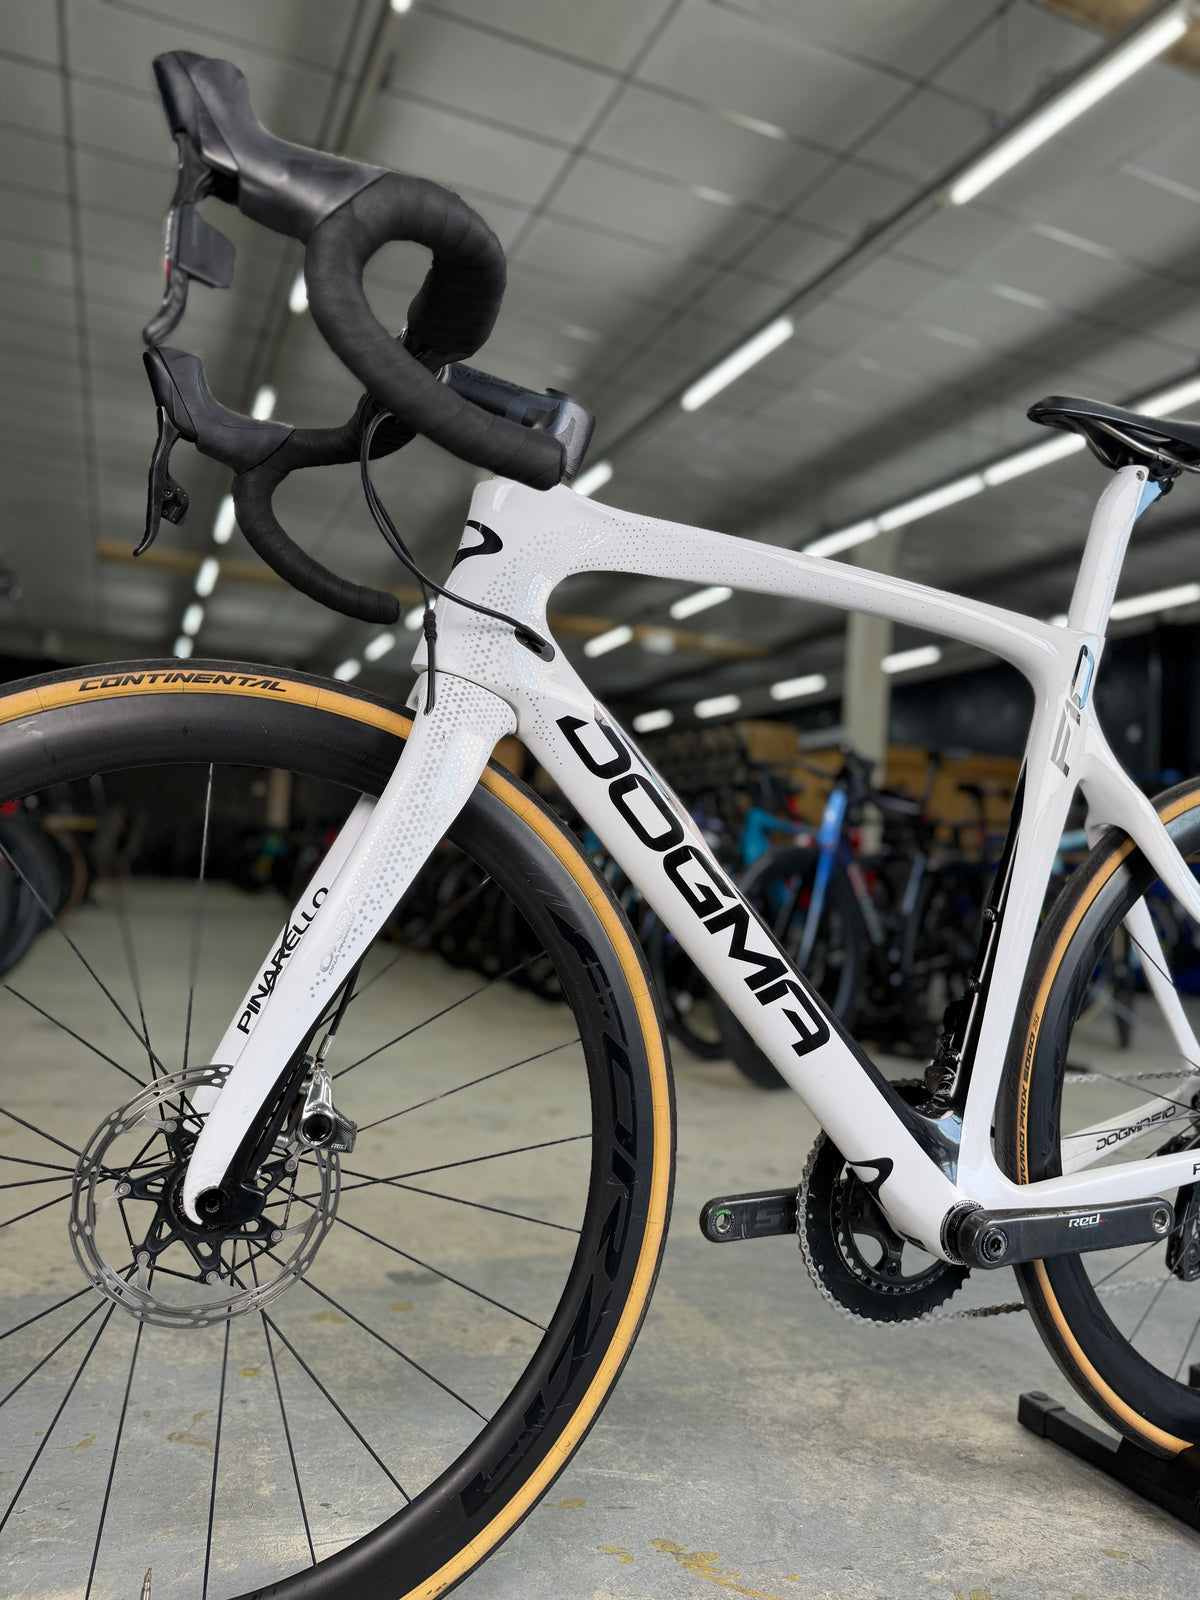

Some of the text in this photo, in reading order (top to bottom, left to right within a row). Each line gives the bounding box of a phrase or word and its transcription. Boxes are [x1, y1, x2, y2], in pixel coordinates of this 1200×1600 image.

[78, 672, 287, 693] CONTINENTAL
[555, 715, 831, 1057] DOGMA
[236, 886, 329, 1035] PINARELLO
[1022, 1032, 1036, 1084] 5000
[1018, 1087, 1028, 1131] PRIX
